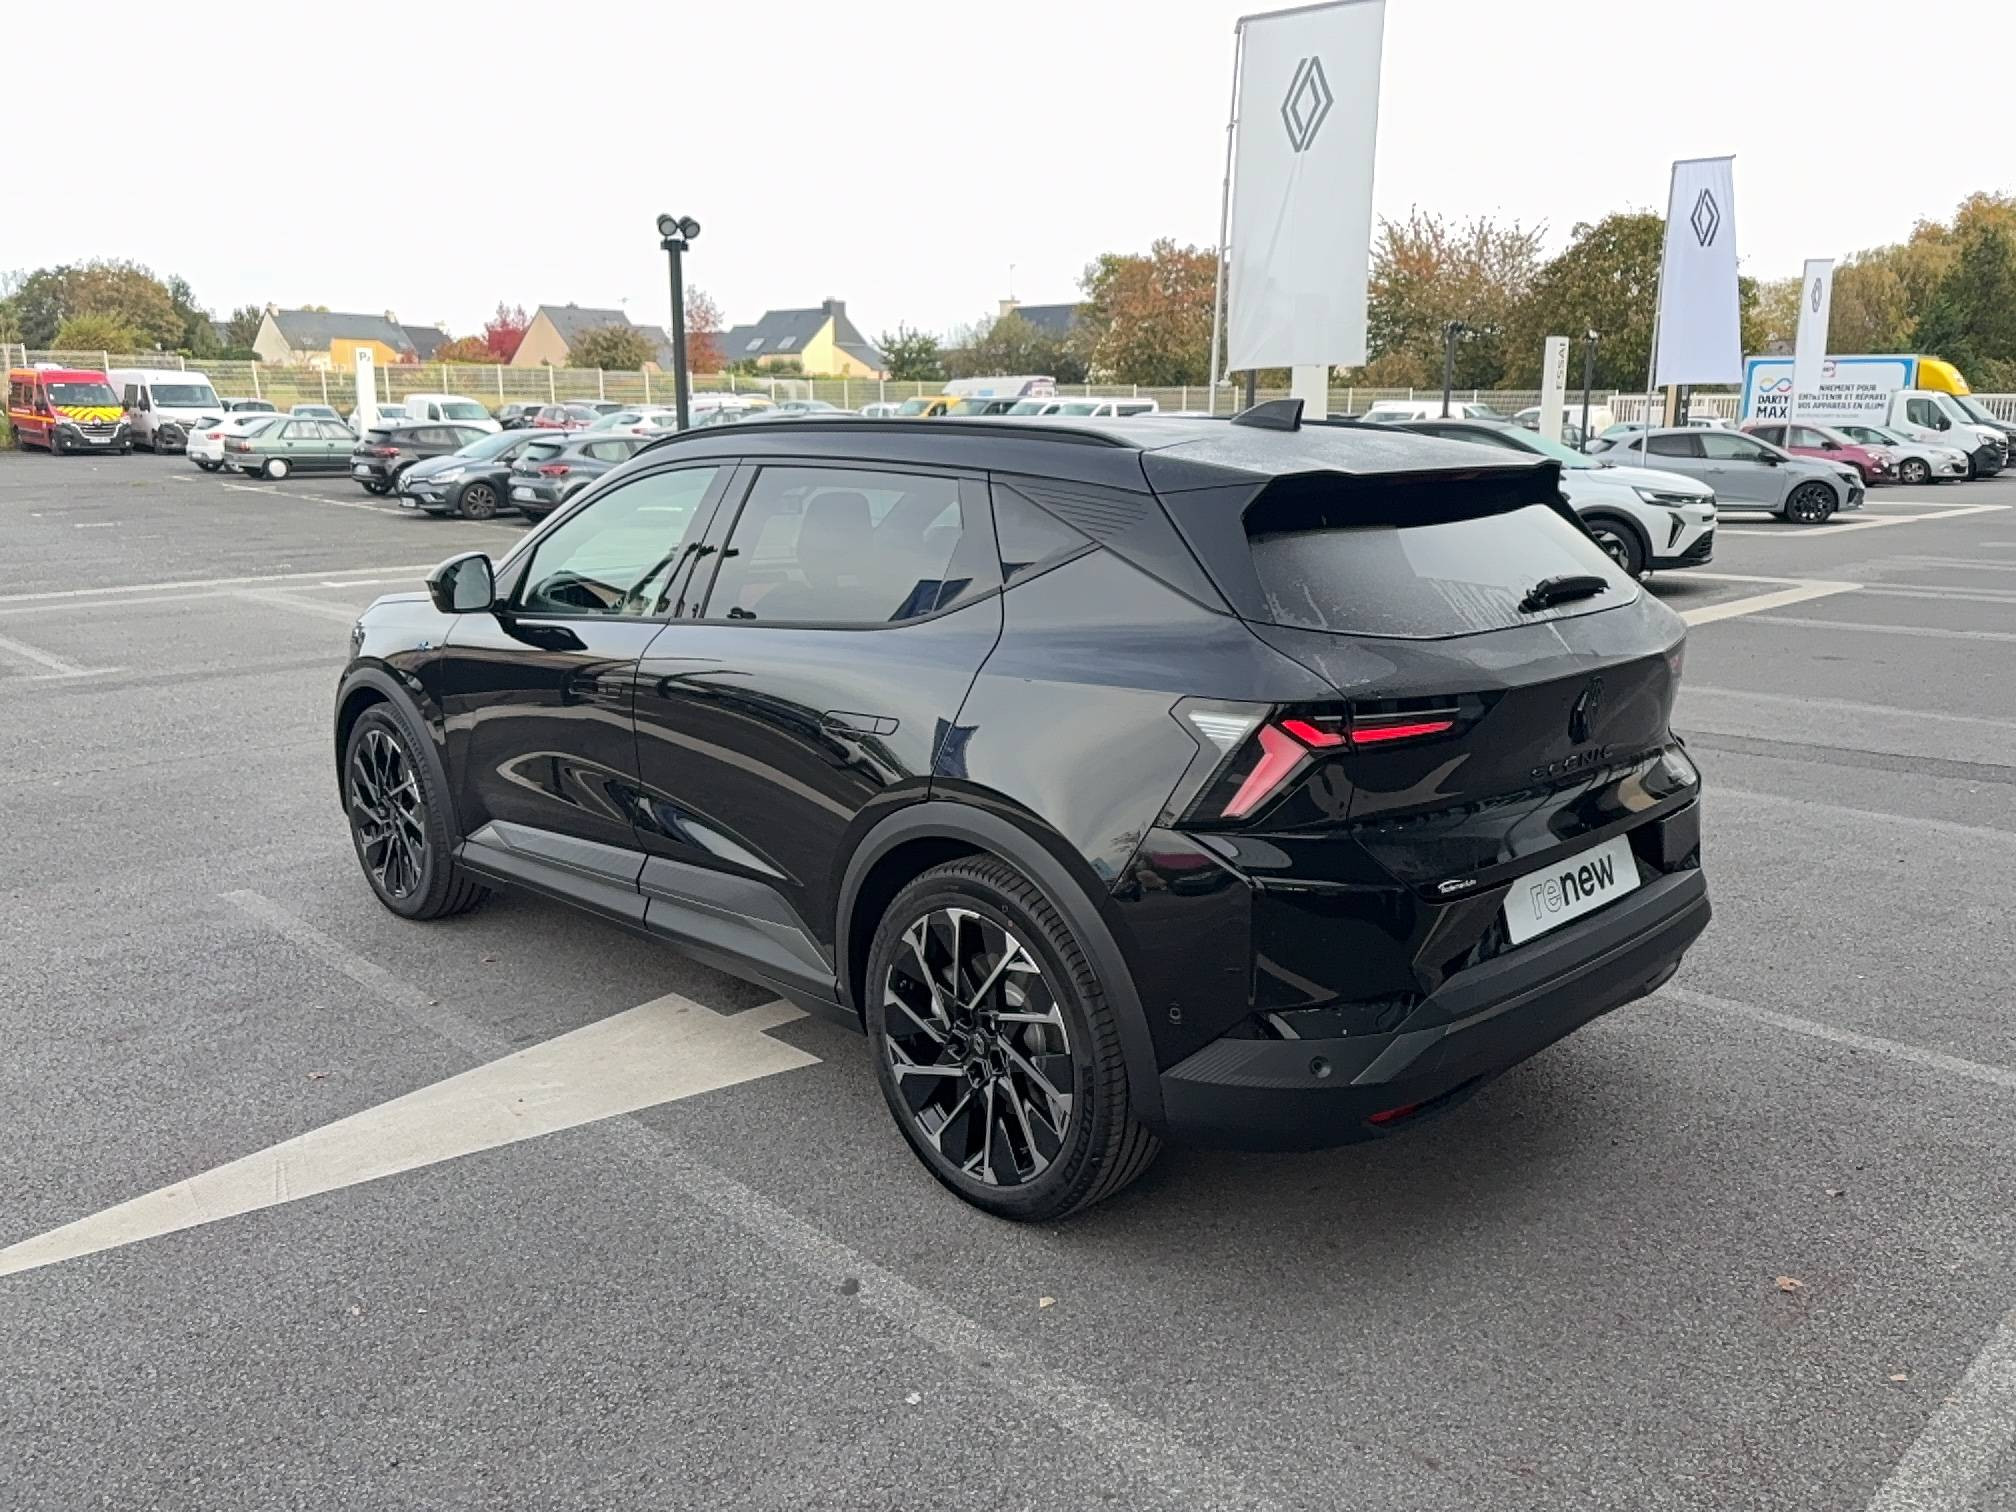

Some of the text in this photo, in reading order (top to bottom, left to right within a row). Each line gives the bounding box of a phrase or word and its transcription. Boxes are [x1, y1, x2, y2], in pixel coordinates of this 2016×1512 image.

[1856, 383, 1877, 391] POUR
[1757, 395, 1789, 404] DARTY
[1755, 406, 1789, 418] MAX
[1529, 743, 1615, 778] SCENIC
[1529, 853, 1615, 920] renew
